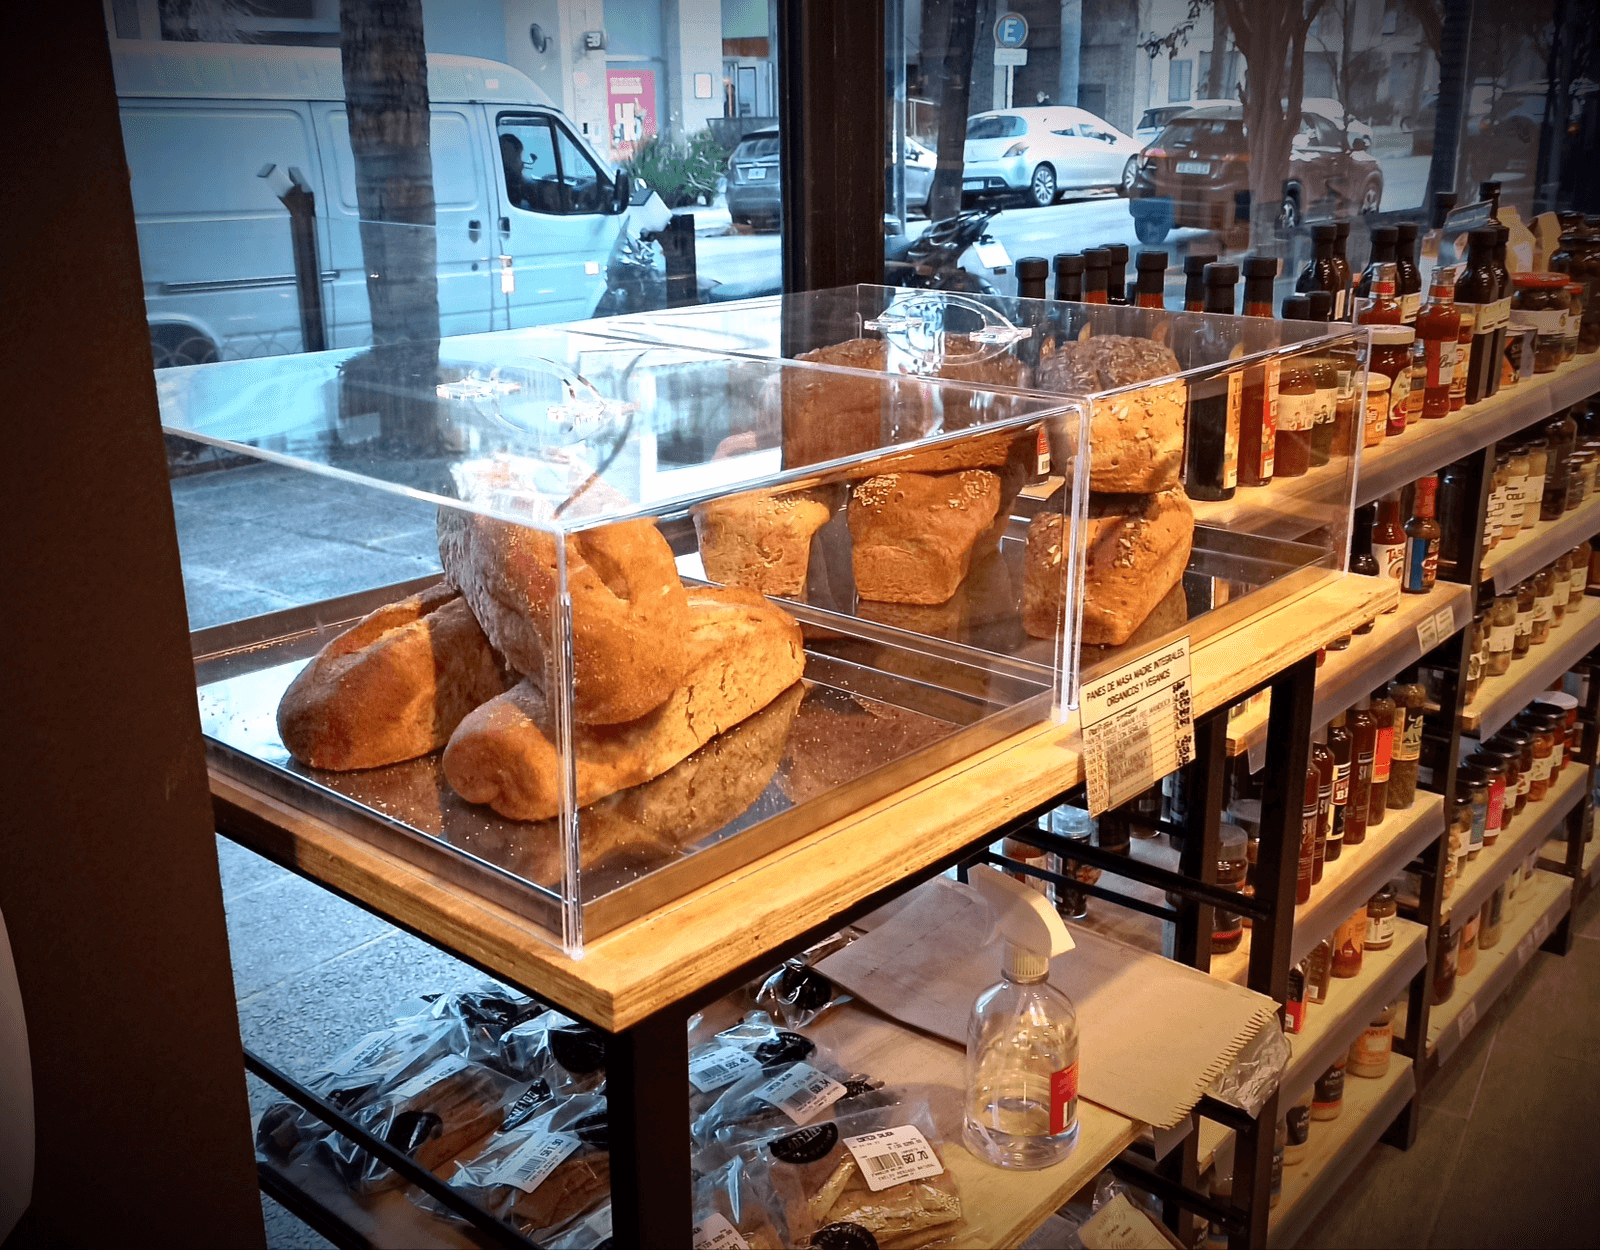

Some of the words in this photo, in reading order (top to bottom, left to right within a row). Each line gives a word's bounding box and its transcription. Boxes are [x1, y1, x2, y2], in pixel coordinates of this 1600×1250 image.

[1004, 20, 1018, 42] E
[1087, 685, 1106, 702] PANES
[1107, 681, 1115, 692] DE
[1116, 673, 1132, 688] MASA
[1134, 663, 1152, 678] MADRE
[1154, 648, 1184, 670] INTEGRALES
[1140, 681, 1144, 690] Y
[1145, 668, 1170, 688] VEGANOS
